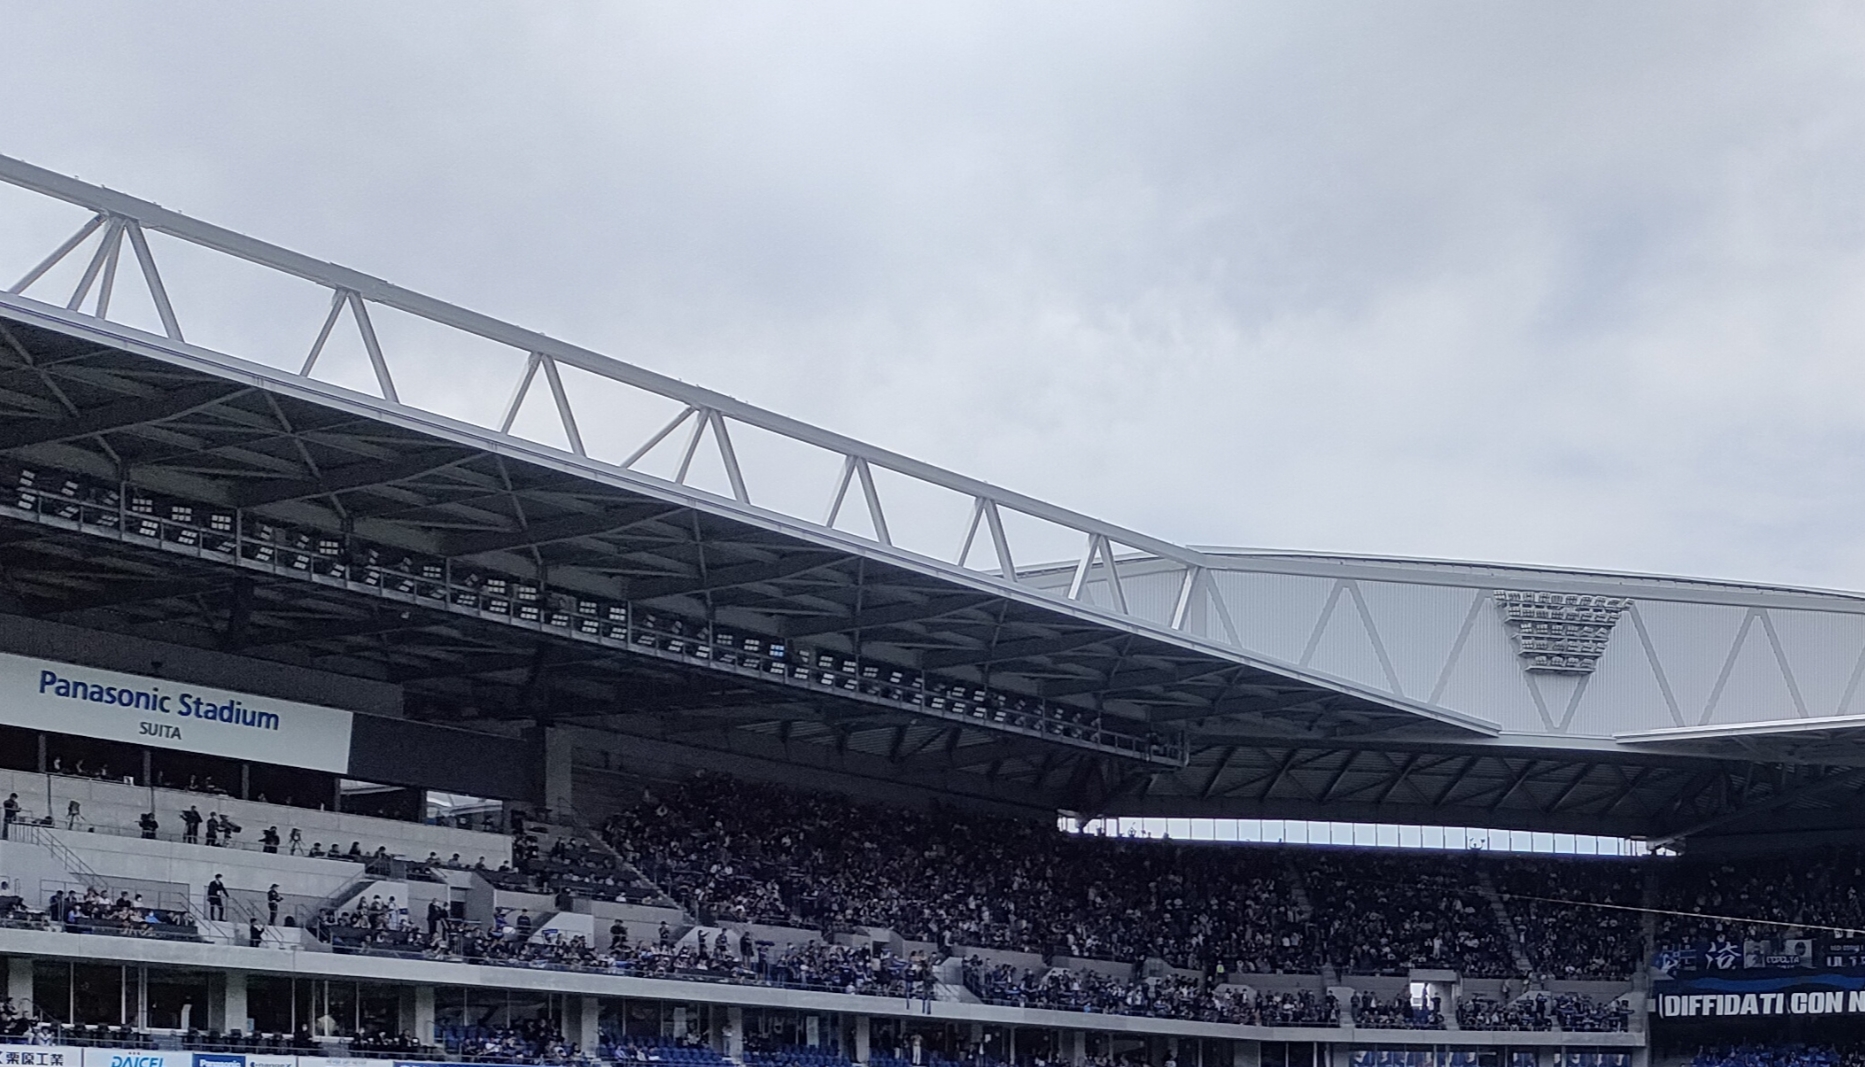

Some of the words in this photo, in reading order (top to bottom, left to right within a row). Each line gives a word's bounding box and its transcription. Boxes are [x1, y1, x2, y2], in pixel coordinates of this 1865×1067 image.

[39, 670, 171, 713] Panasonic
[178, 693, 280, 731] Stadium
[139, 721, 182, 741] SUITA
[1664, 993, 1785, 1017] DIFFIDATI
[1790, 991, 1842, 1015] CON
